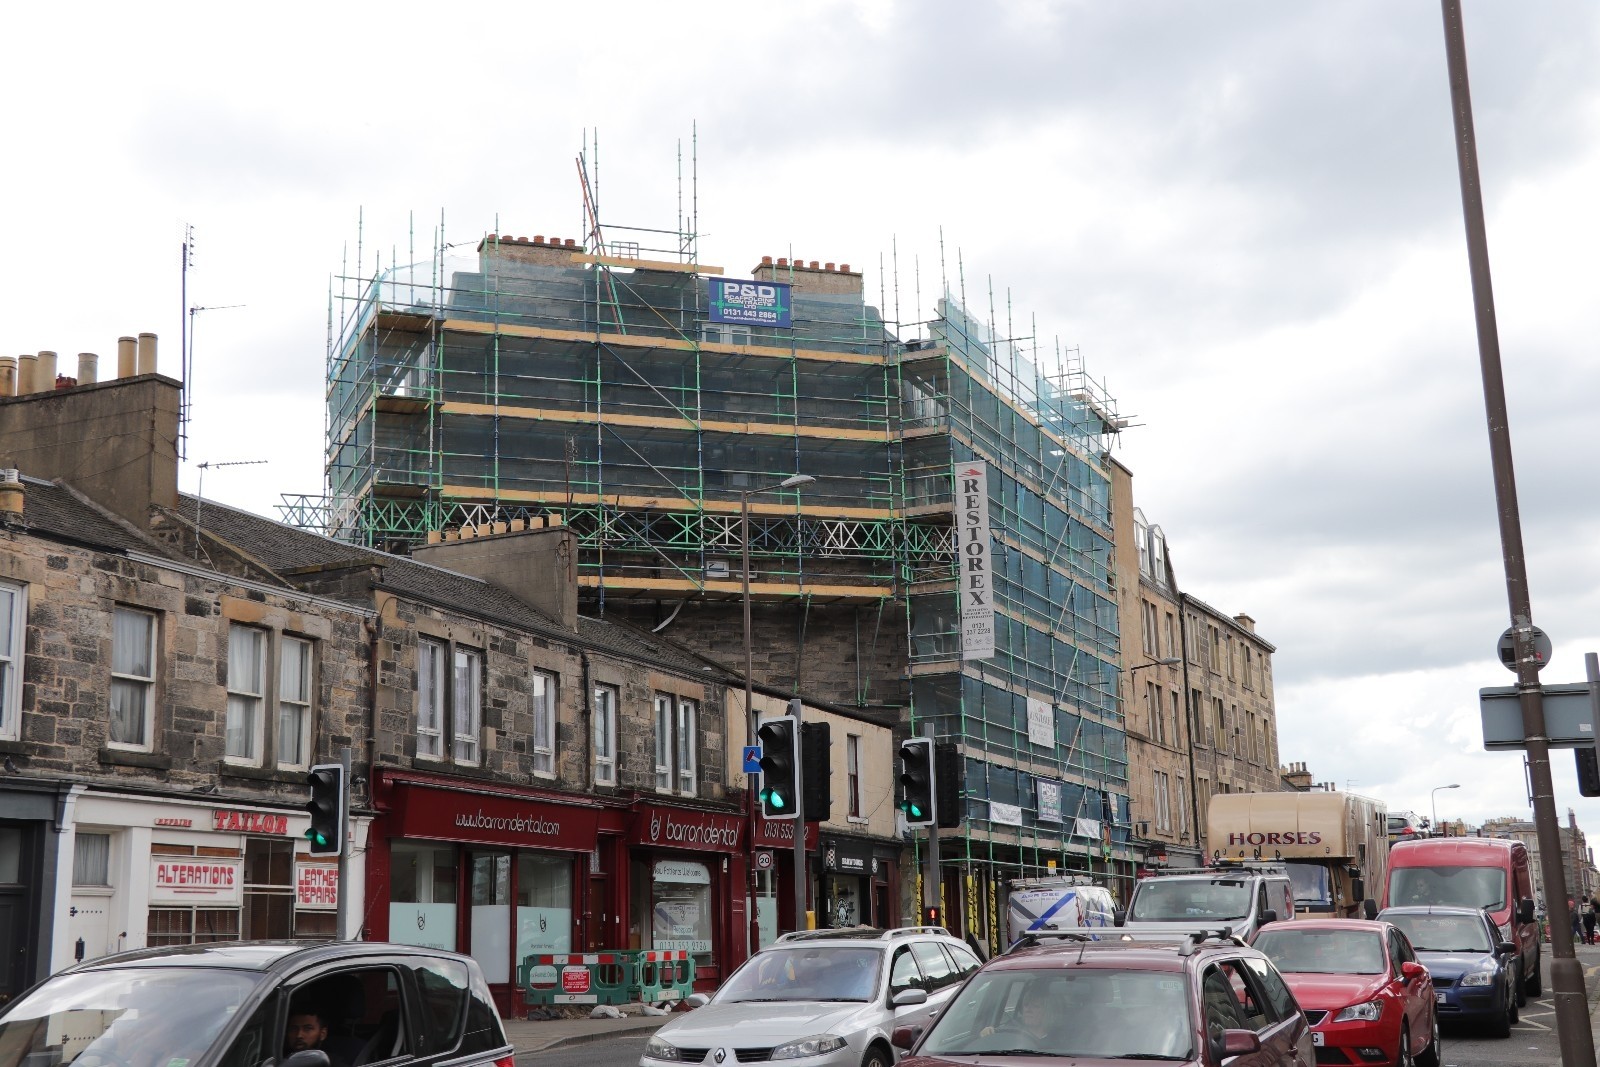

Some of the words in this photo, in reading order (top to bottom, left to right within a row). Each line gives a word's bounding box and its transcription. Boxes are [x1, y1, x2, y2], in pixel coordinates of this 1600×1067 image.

[723, 282, 775, 299] P&D
[724, 295, 775, 303] SCAFFOLDING
[727, 298, 773, 307] CONTRACTS
[758, 311, 777, 319] 2864
[962, 478, 986, 606] RESTOREX
[213, 810, 288, 835] TAILOR
[764, 821, 780, 838] 0131
[780, 823, 794, 840] 553
[1228, 831, 1322, 846] HORSES
[157, 864, 234, 885] ALTERATIONS
[298, 886, 337, 904] REPAIRS
